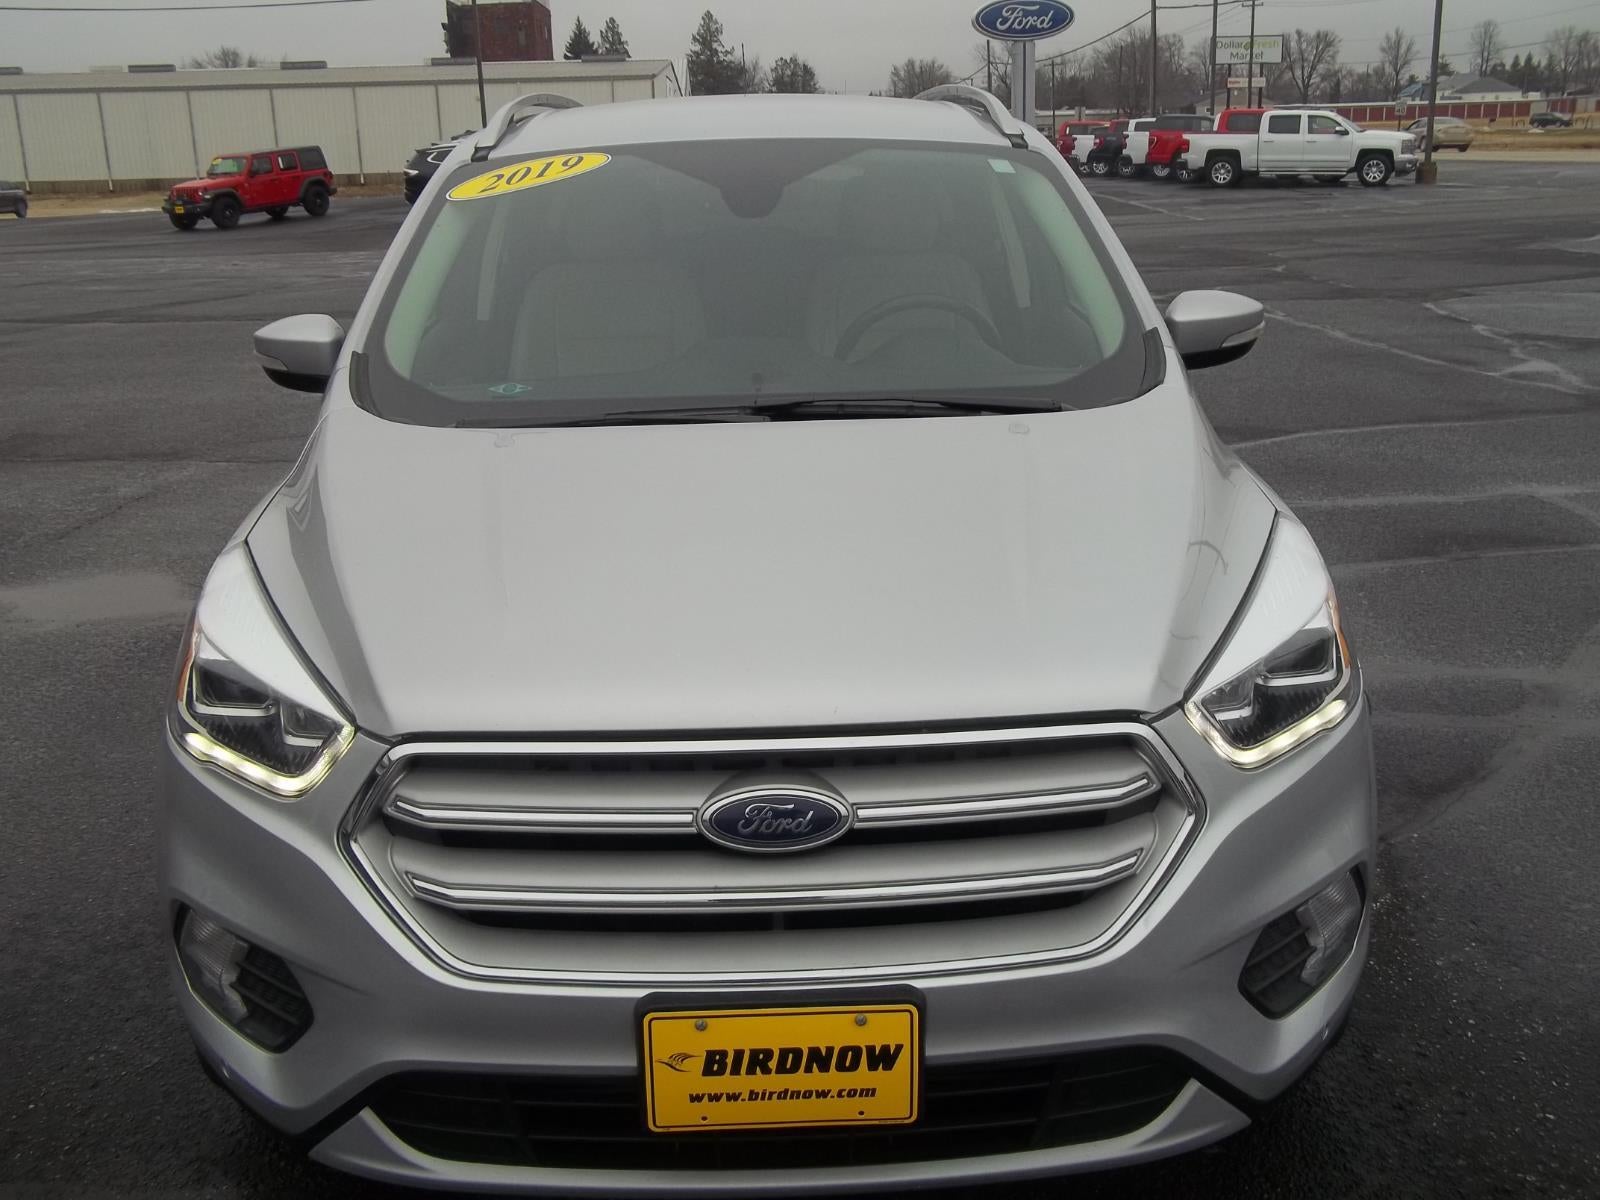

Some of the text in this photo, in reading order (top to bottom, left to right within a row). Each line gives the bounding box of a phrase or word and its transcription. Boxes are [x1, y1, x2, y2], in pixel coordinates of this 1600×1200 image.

[996, 5, 1053, 30] Ford
[1216, 40, 1243, 49] Dollar
[1230, 51, 1264, 60] Maret
[477, 155, 584, 194] 2019
[737, 803, 814, 834] Ford
[701, 1043, 904, 1077] BIRDNOW
[688, 1087, 877, 1104] www.birdnow.com
